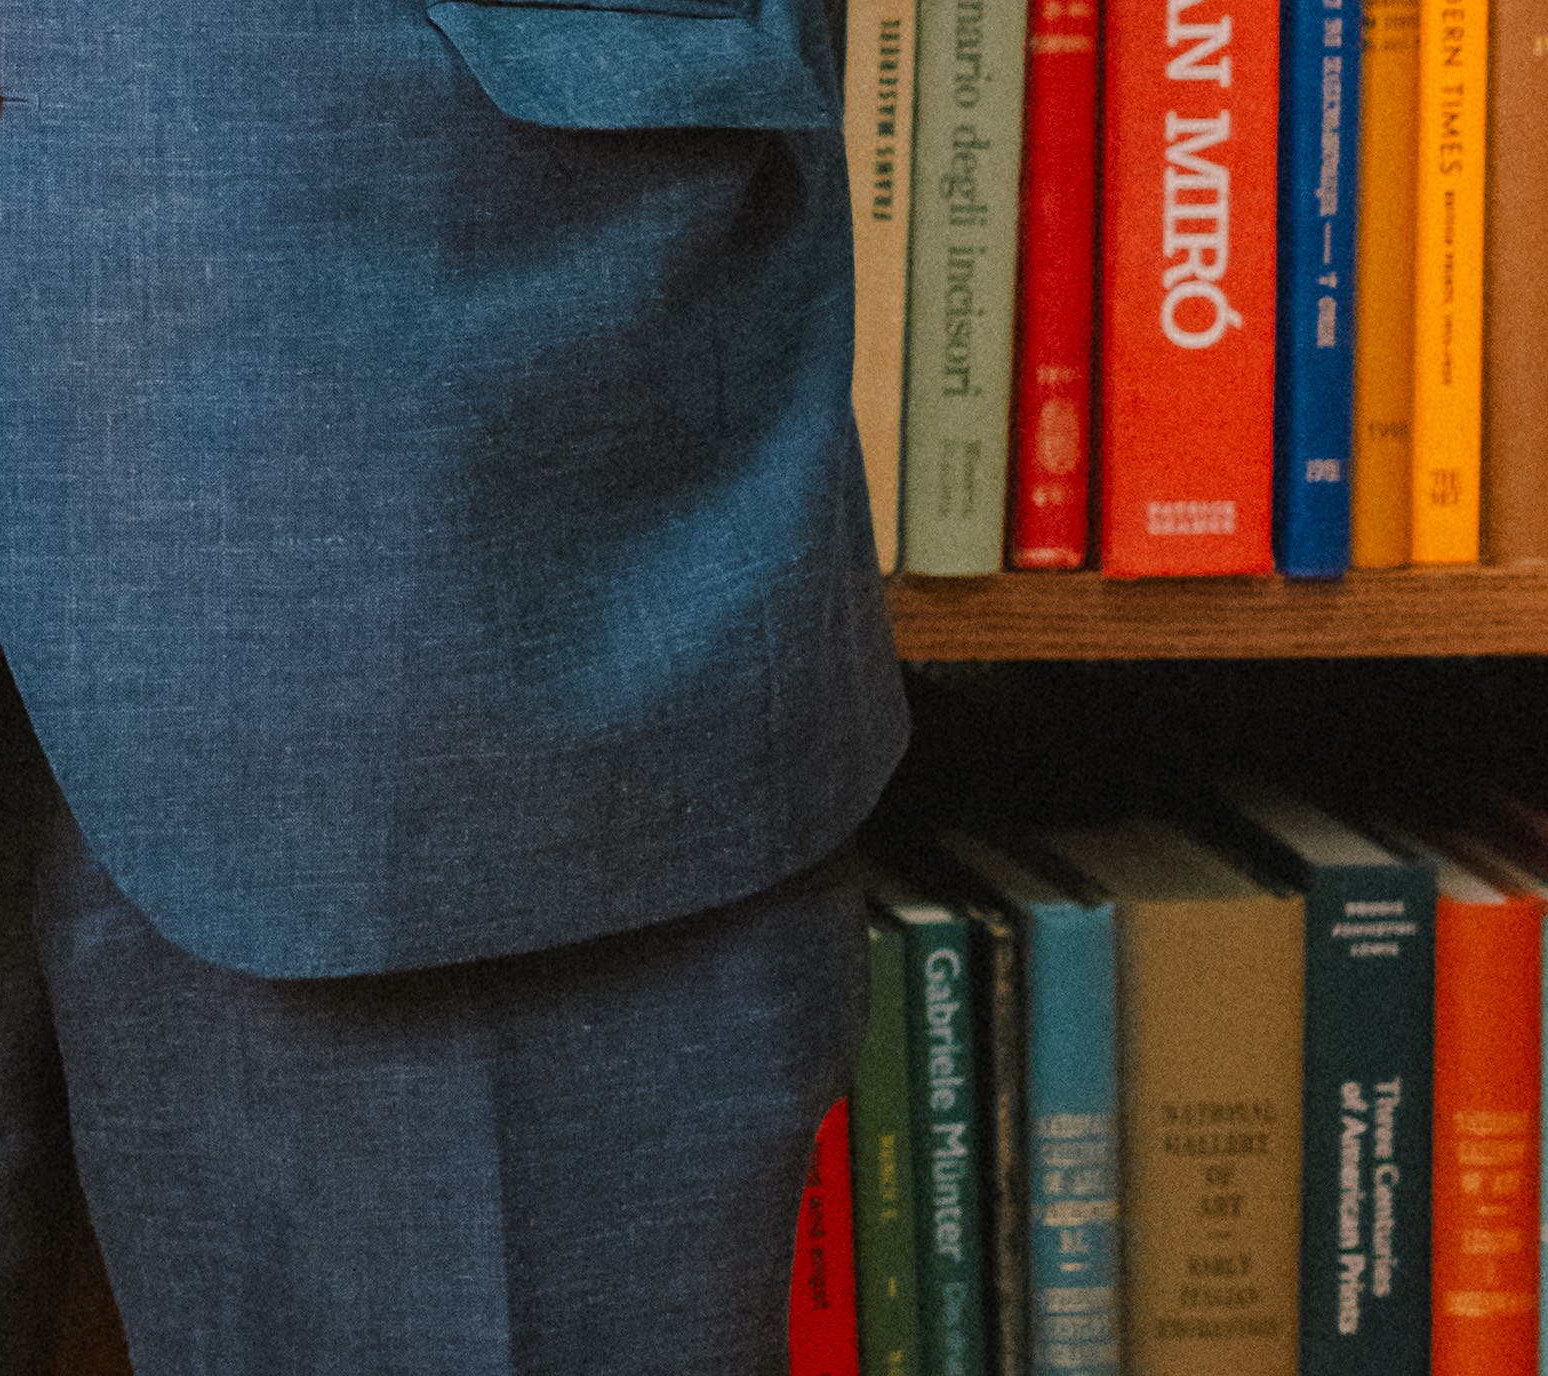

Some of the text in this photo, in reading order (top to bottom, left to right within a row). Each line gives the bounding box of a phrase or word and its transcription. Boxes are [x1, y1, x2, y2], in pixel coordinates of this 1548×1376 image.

[871, 19, 902, 222] FRANS MASEREEL
[938, 124, 992, 229] degli
[1439, 82, 1465, 176] TIMES
[1159, 109, 1244, 351] MIRÓ
[942, 244, 987, 398] incisori
[924, 947, 970, 1263] Gabriele Münter
[1163, 1133, 1269, 1156] GALLERY
[1204, 1165, 1234, 1187] OF
[1201, 1194, 1244, 1218] ART
[1337, 1080, 1369, 1335] of American Prints
[1373, 1076, 1402, 1298] Three Centuries
